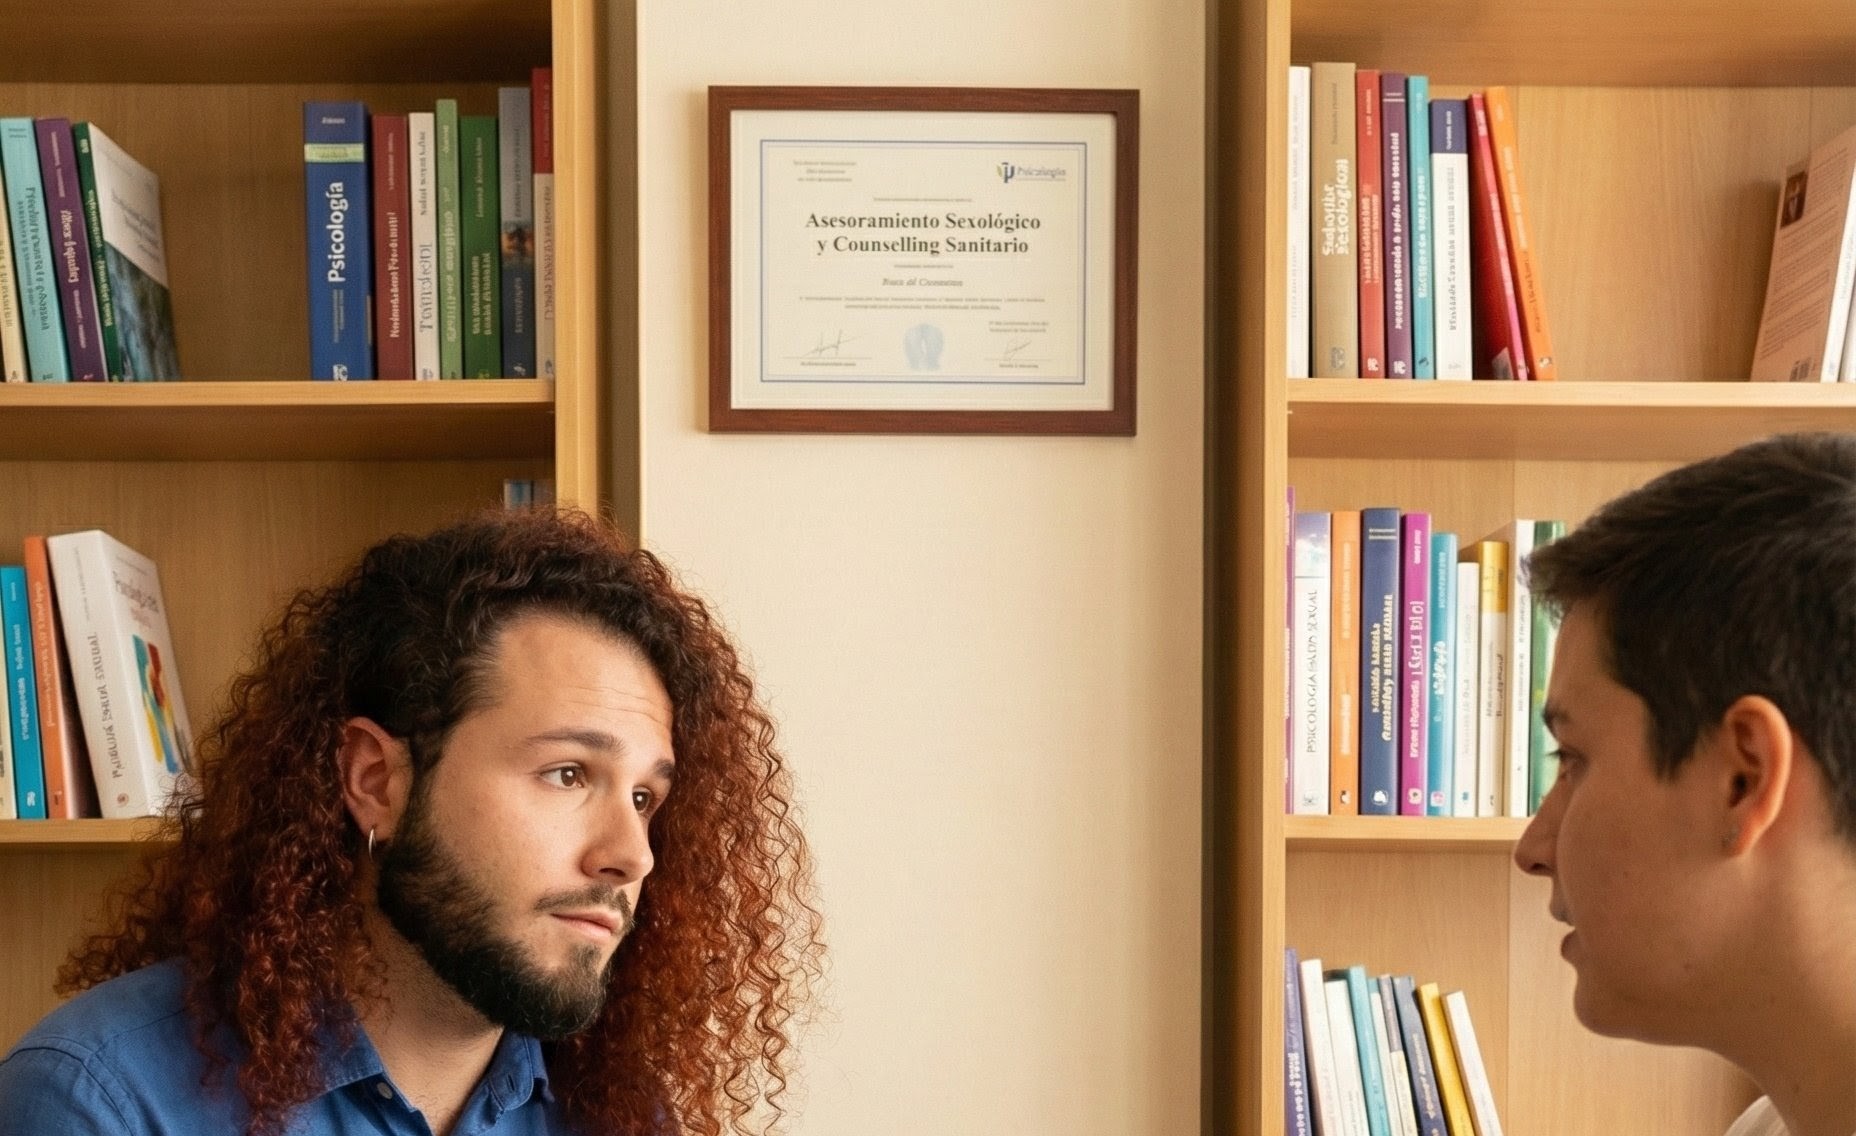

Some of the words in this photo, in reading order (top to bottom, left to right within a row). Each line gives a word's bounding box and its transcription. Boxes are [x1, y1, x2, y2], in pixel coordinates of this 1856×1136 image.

[325, 182, 349, 283] Psicología
[806, 212, 940, 229] Asesoramiento
[945, 212, 1041, 233] Sexológico
[817, 239, 828, 255] y
[833, 235, 940, 254] Counselling
[945, 236, 1029, 253] Sanitario
